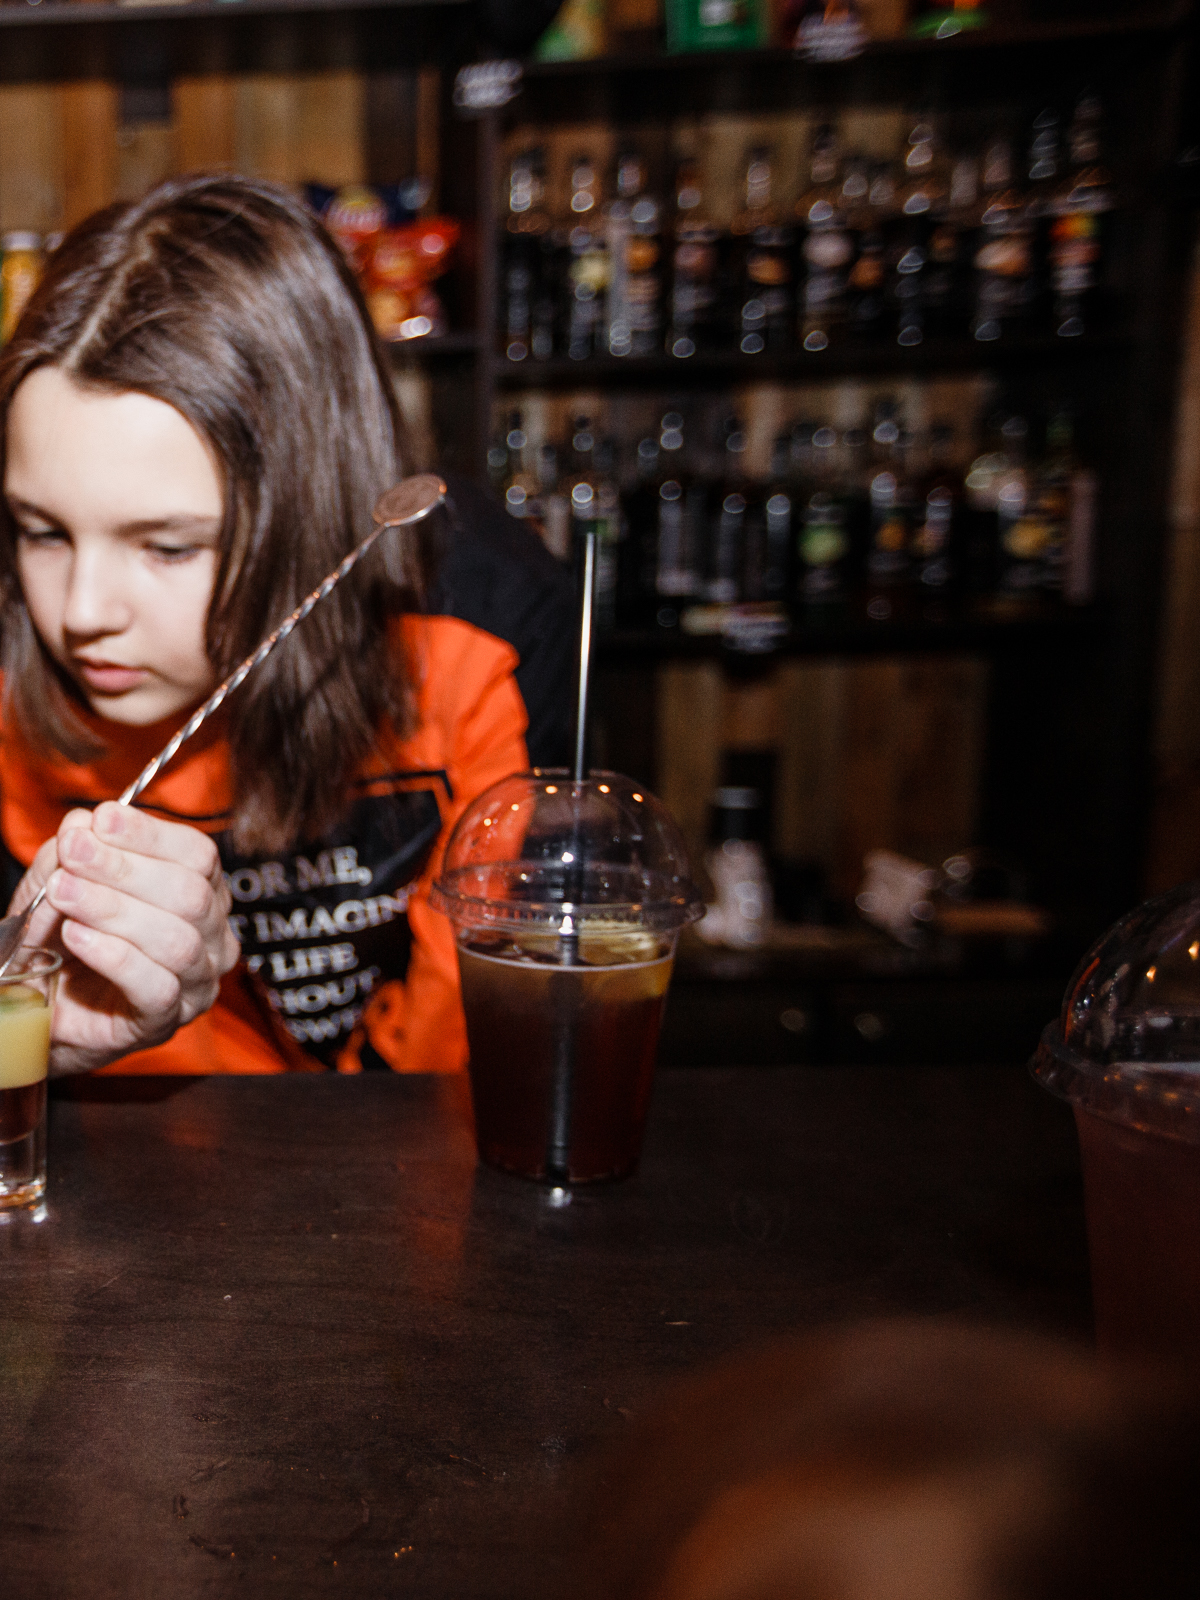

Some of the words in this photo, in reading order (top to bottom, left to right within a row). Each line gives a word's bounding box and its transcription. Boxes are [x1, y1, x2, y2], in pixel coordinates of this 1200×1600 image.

[224, 861, 291, 902] OR
[254, 883, 419, 943] IMAGIN
[271, 942, 359, 983] LIFE
